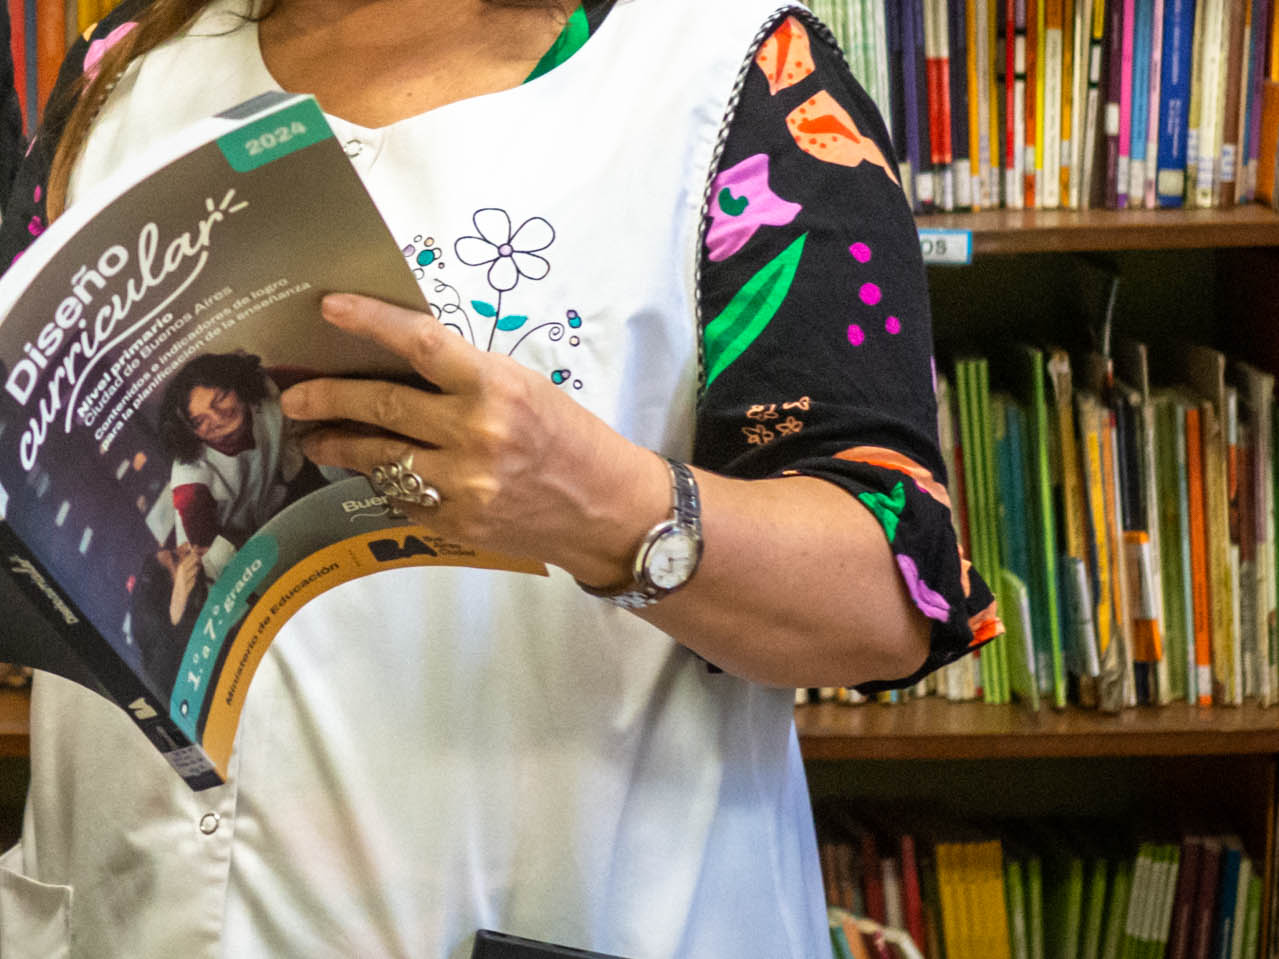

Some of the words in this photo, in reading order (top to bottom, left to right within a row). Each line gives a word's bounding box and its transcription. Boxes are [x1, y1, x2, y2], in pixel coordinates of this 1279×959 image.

[245, 121, 307, 156] 2024
[4, 244, 129, 406] Diseño
[19, 209, 224, 471] curricular
[76, 371, 112, 418] Nivel
[110, 312, 174, 378] primario
[83, 375, 125, 427] Ciudad
[123, 357, 141, 378] de
[139, 312, 193, 360] Buenos
[194, 285, 233, 315] Aires
[94, 370, 152, 441] Contenidos
[151, 362, 161, 373] e
[159, 306, 233, 366] indicadores
[232, 295, 252, 311] de
[250, 278, 289, 300] logro
[101, 419, 124, 452] para
[121, 407, 135, 422] la
[132, 338, 206, 410] planificación
[204, 326, 222, 343] de
[221, 318, 237, 330] la
[235, 281, 312, 322] enseñanza
[201, 644, 211, 660] a
[223, 558, 263, 615] grado
[225, 634, 260, 708] Ministerio
[257, 615, 271, 636] de
[269, 561, 341, 616] Educación
